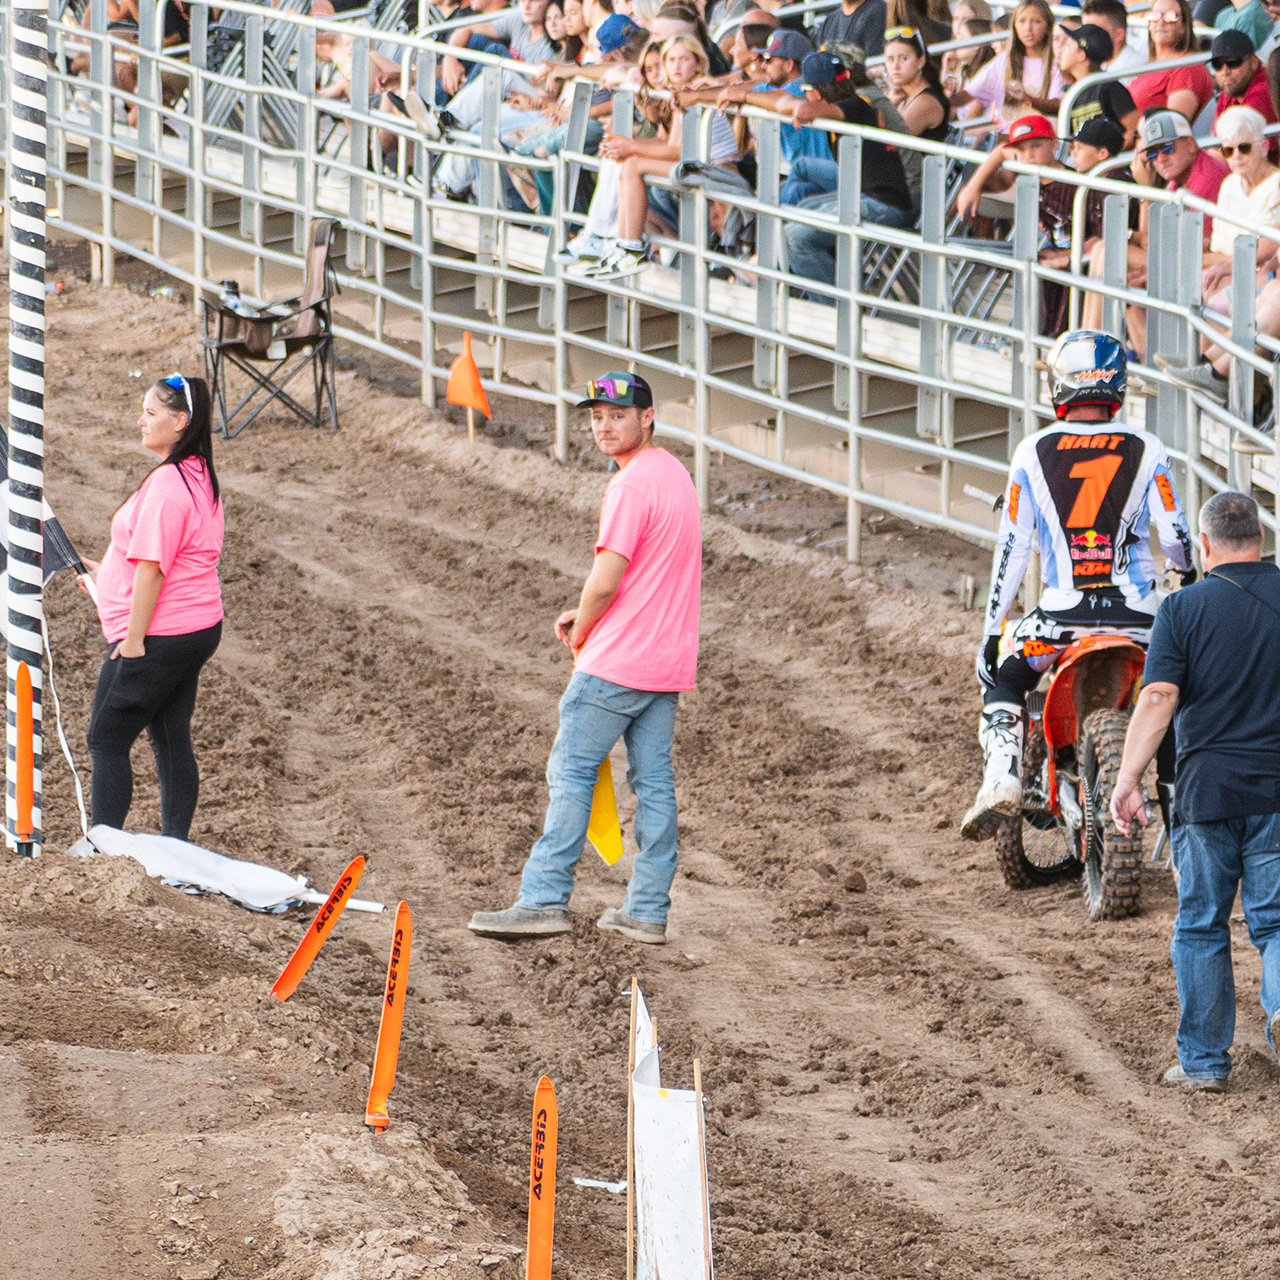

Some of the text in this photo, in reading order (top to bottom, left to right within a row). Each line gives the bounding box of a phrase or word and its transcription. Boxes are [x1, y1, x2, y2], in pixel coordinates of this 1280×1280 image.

[1077, 369, 1118, 383] HART
[1057, 434, 1125, 450] HART
[1066, 454, 1124, 528] 1
[1071, 548, 1112, 560] Red Bull
[1073, 561, 1112, 576] KTM
